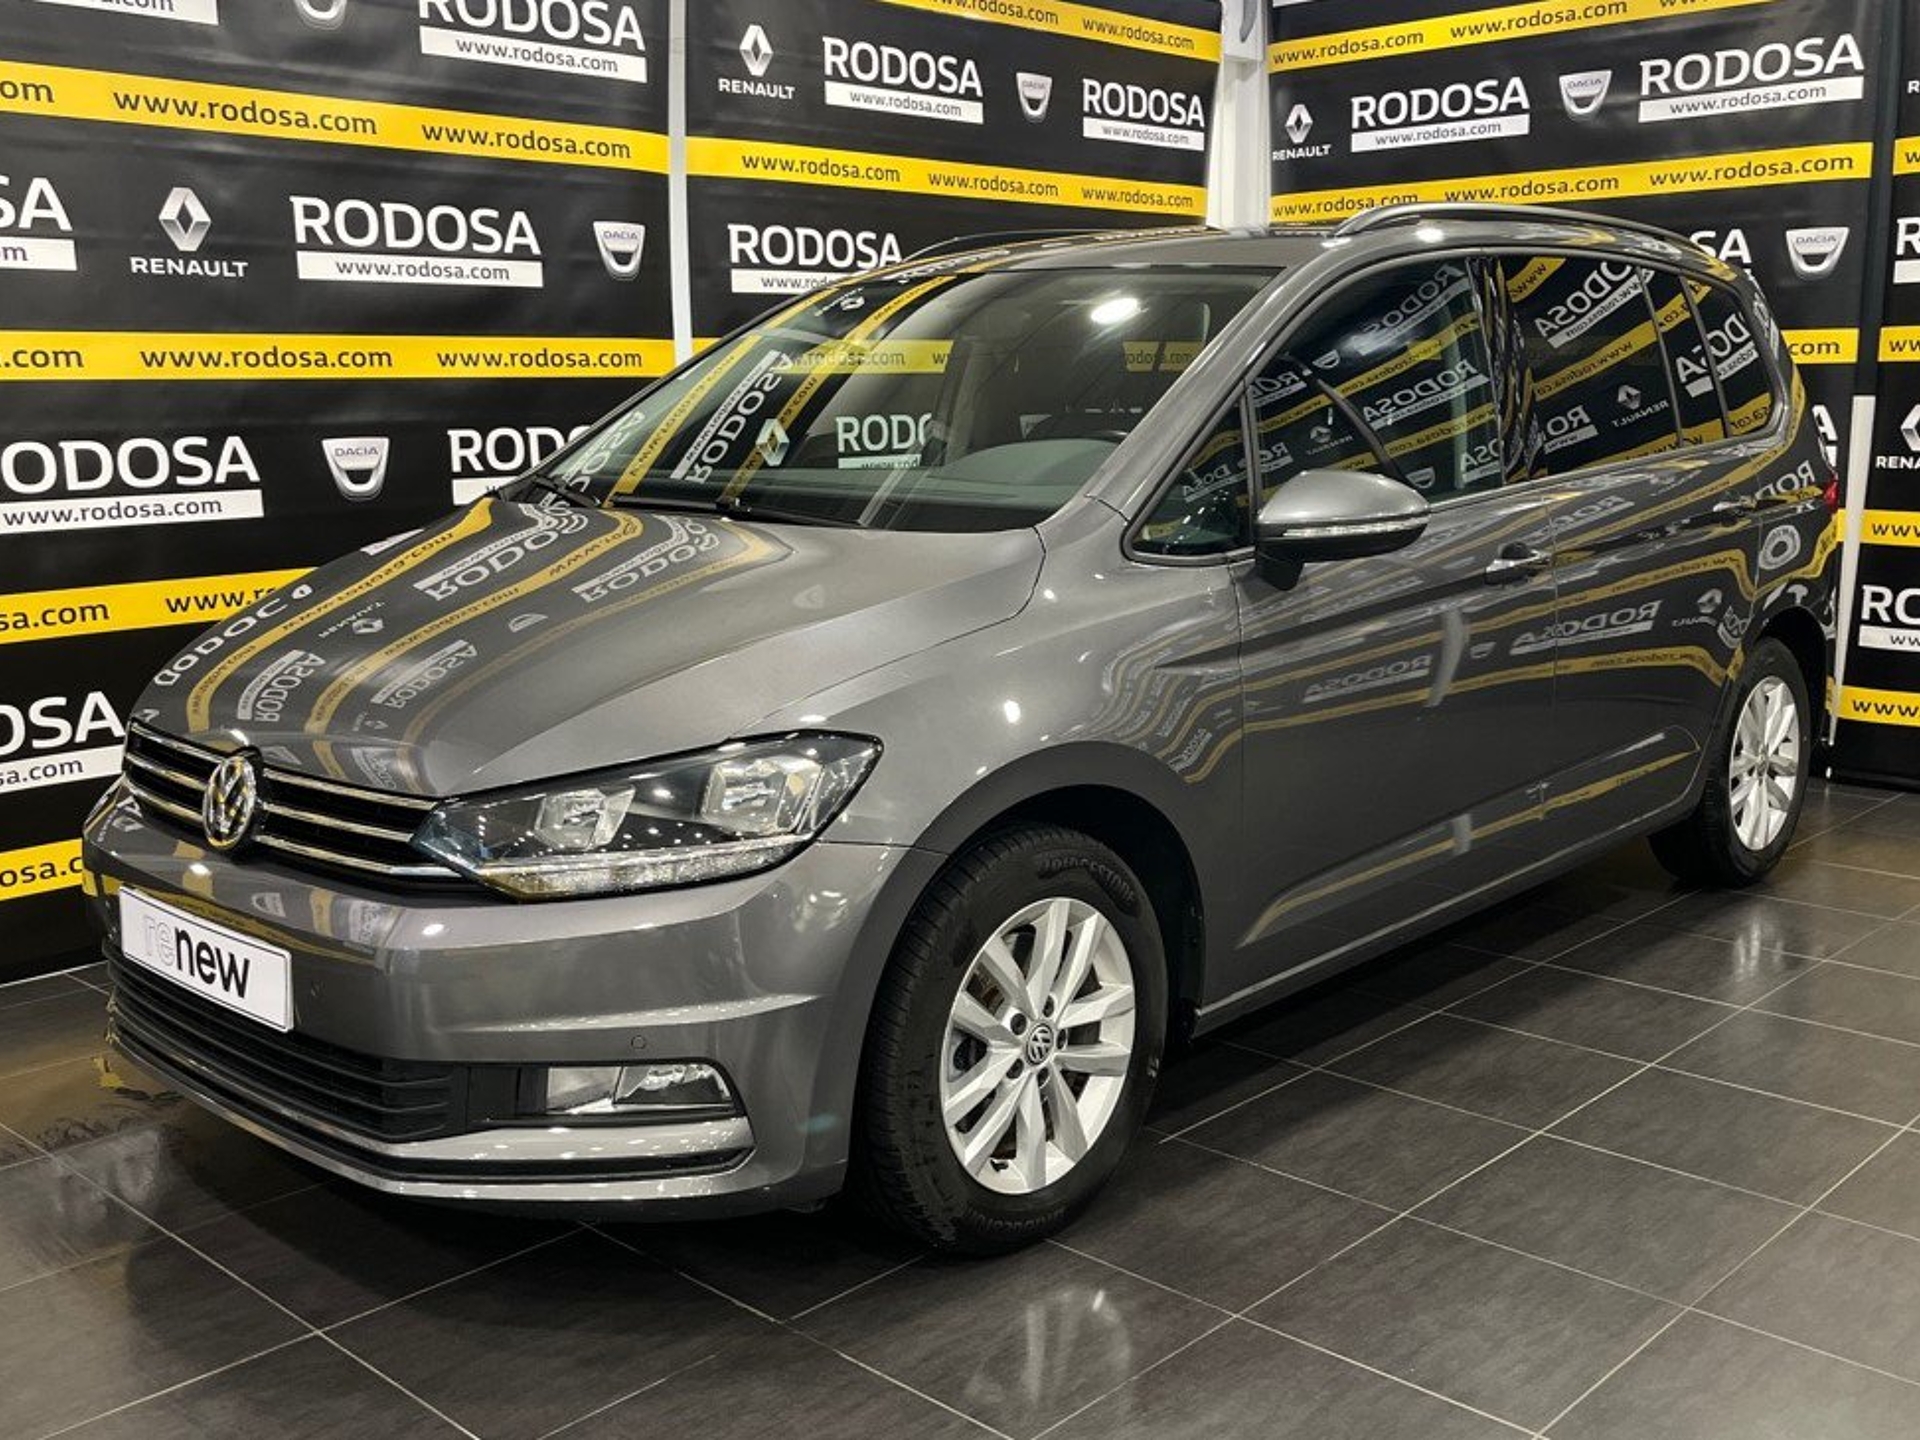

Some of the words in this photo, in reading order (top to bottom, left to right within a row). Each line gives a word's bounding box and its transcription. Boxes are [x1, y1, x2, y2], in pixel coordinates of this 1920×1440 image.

[929, 0, 1059, 25] w.rodosa.com
[1450, 2, 1628, 38] www.rodosa.com
[1083, 18, 1195, 50] www.rodosa.com
[456, 37, 618, 73] www.rodosa.com
[1273, 31, 1424, 65] www.rodosa.com
[822, 36, 983, 98] RODOSA
[1639, 33, 1865, 96] RODOSA
[718, 77, 796, 99] RENAULT
[1566, 77, 1604, 90] DACIA
[113, 91, 377, 135] www.rodosa.com
[850, 90, 962, 117] www.rodosa.com
[1083, 78, 1205, 128] RODOSA
[1350, 76, 1531, 130] RODOSA
[1669, 84, 1827, 115] www.rodosa.com
[422, 123, 631, 159] www.rodosa.com
[1102, 120, 1189, 145] www.rodosa.com
[1375, 121, 1502, 146] www.rodosa.com
[1272, 144, 1332, 161] RENAULT
[741, 154, 901, 183] www.rodosa.com
[1650, 154, 1854, 187] www.rodosa.com
[928, 171, 1059, 197] www.rodosa.com
[1082, 186, 1193, 209] www.rodosa.com
[1444, 174, 1620, 202] www.rodosa.com
[289, 195, 541, 255] RODOSA
[603, 230, 638, 241] DACIA
[727, 223, 903, 269] RODOSA
[130, 256, 249, 277] RENAULT
[336, 259, 510, 281] www.rodosa.com
[140, 346, 393, 368] www.rodosa.com
[438, 348, 642, 368] www.rodosa.com
[334, 446, 379, 458] DACIA
[3, 500, 223, 527] www.rodosa.com
[0, 758, 84, 785] a.com
[142, 913, 251, 999] renew
